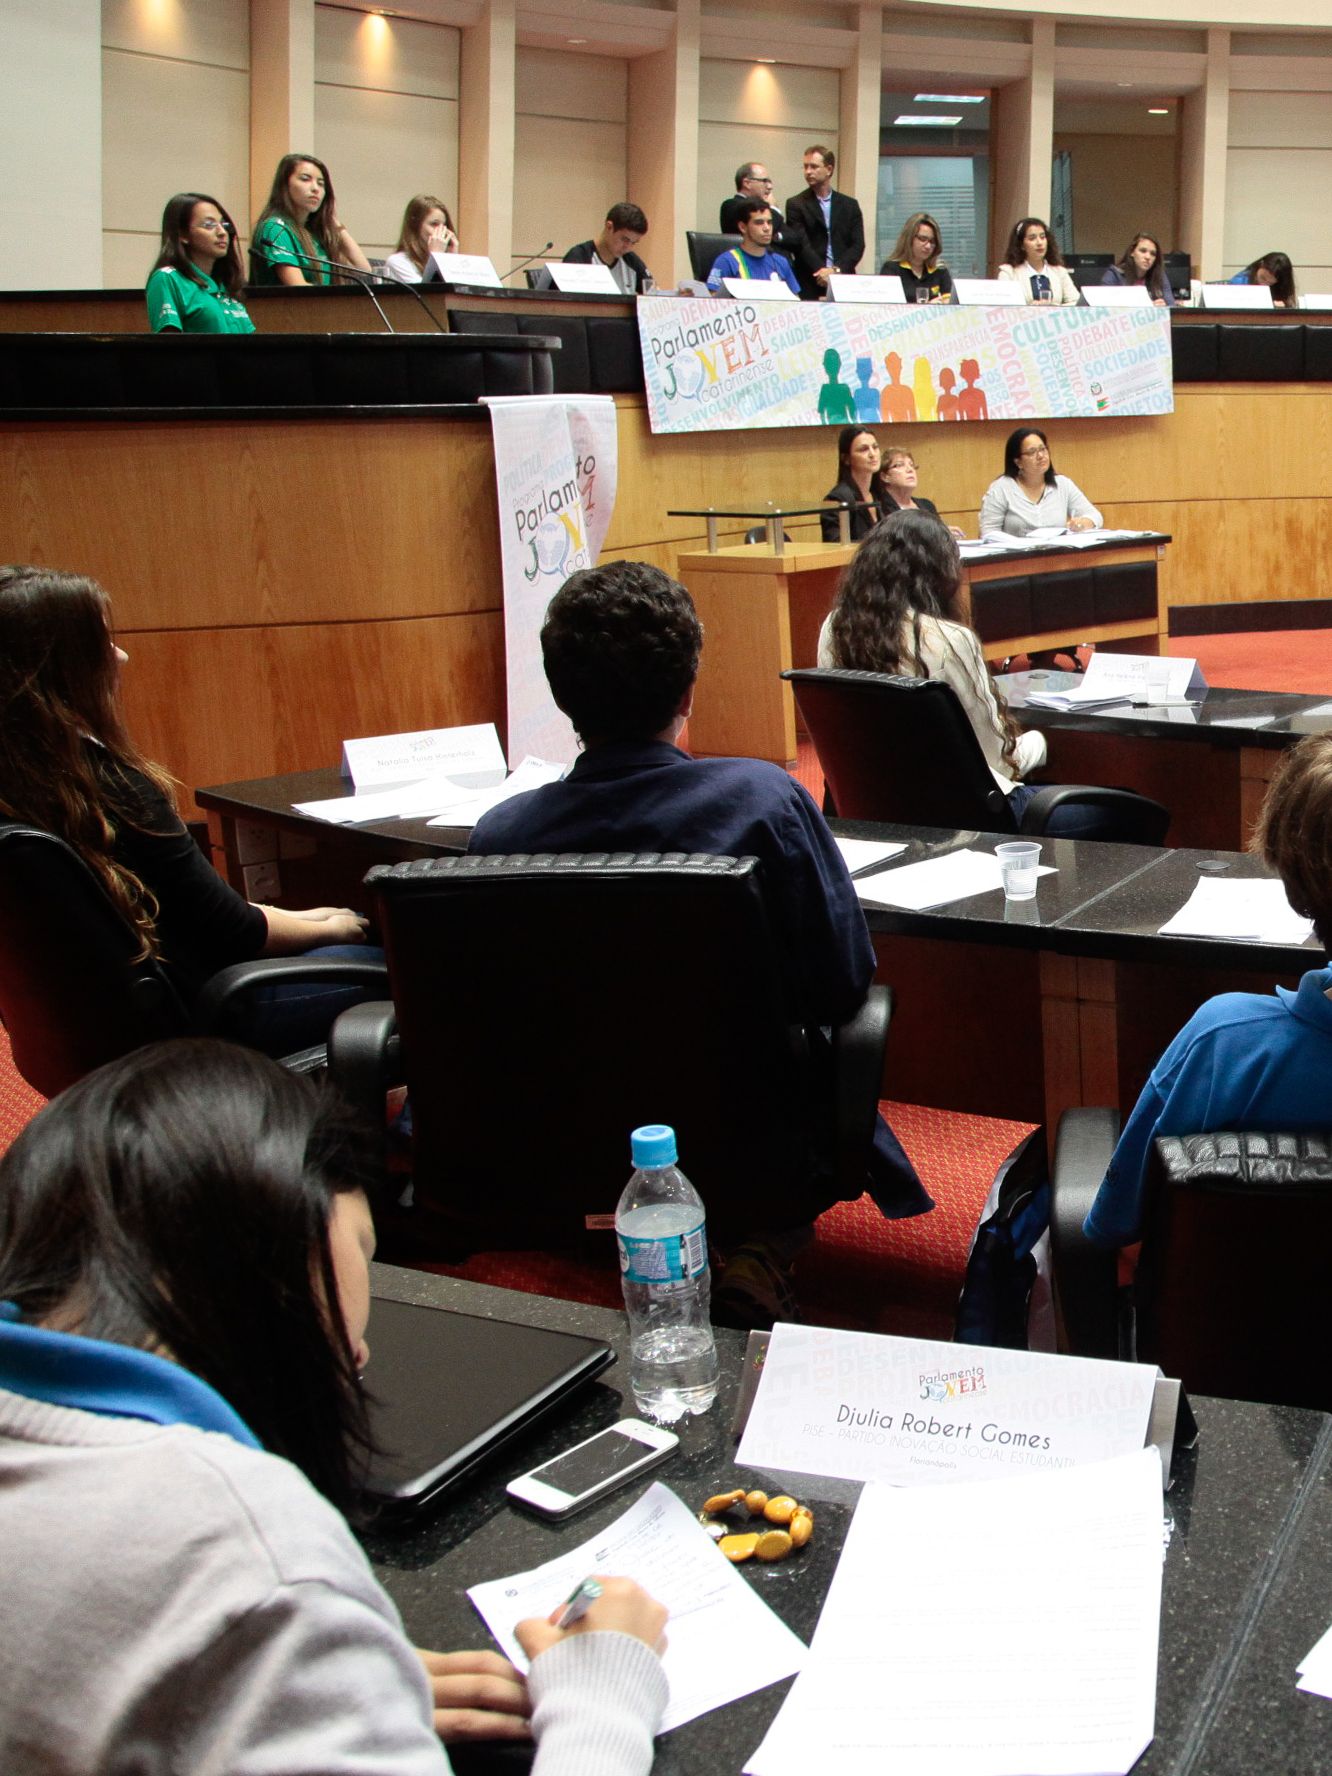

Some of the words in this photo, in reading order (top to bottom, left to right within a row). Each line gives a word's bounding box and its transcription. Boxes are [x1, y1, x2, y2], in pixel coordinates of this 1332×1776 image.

[651, 305, 756, 364] Parlamento
[763, 306, 807, 335] DEBATE
[1012, 306, 1110, 348] CULTURA
[1071, 315, 1131, 349] DEBATE
[1127, 323, 1162, 347] LEIS
[663, 323, 770, 401] JOVEM
[777, 343, 821, 380] LEIS
[1078, 337, 1127, 363] CULTURA
[1083, 337, 1170, 380] SOCIEDADE
[701, 359, 774, 403] catarinense
[919, 1366, 984, 1388] Parlamento
[919, 1374, 988, 1402] JOVEM
[802, 1423, 825, 1439] PISE
[838, 1428, 886, 1446] PARTIDO
[889, 1435, 957, 1455] INOVAÇÃO
[960, 1444, 1005, 1462] SOCIAL
[836, 1404, 894, 1430] Djulia
[900, 1412, 973, 1439] Robert
[980, 1423, 1051, 1450] Gomes
[909, 1456, 957, 1469] Florianópolis
